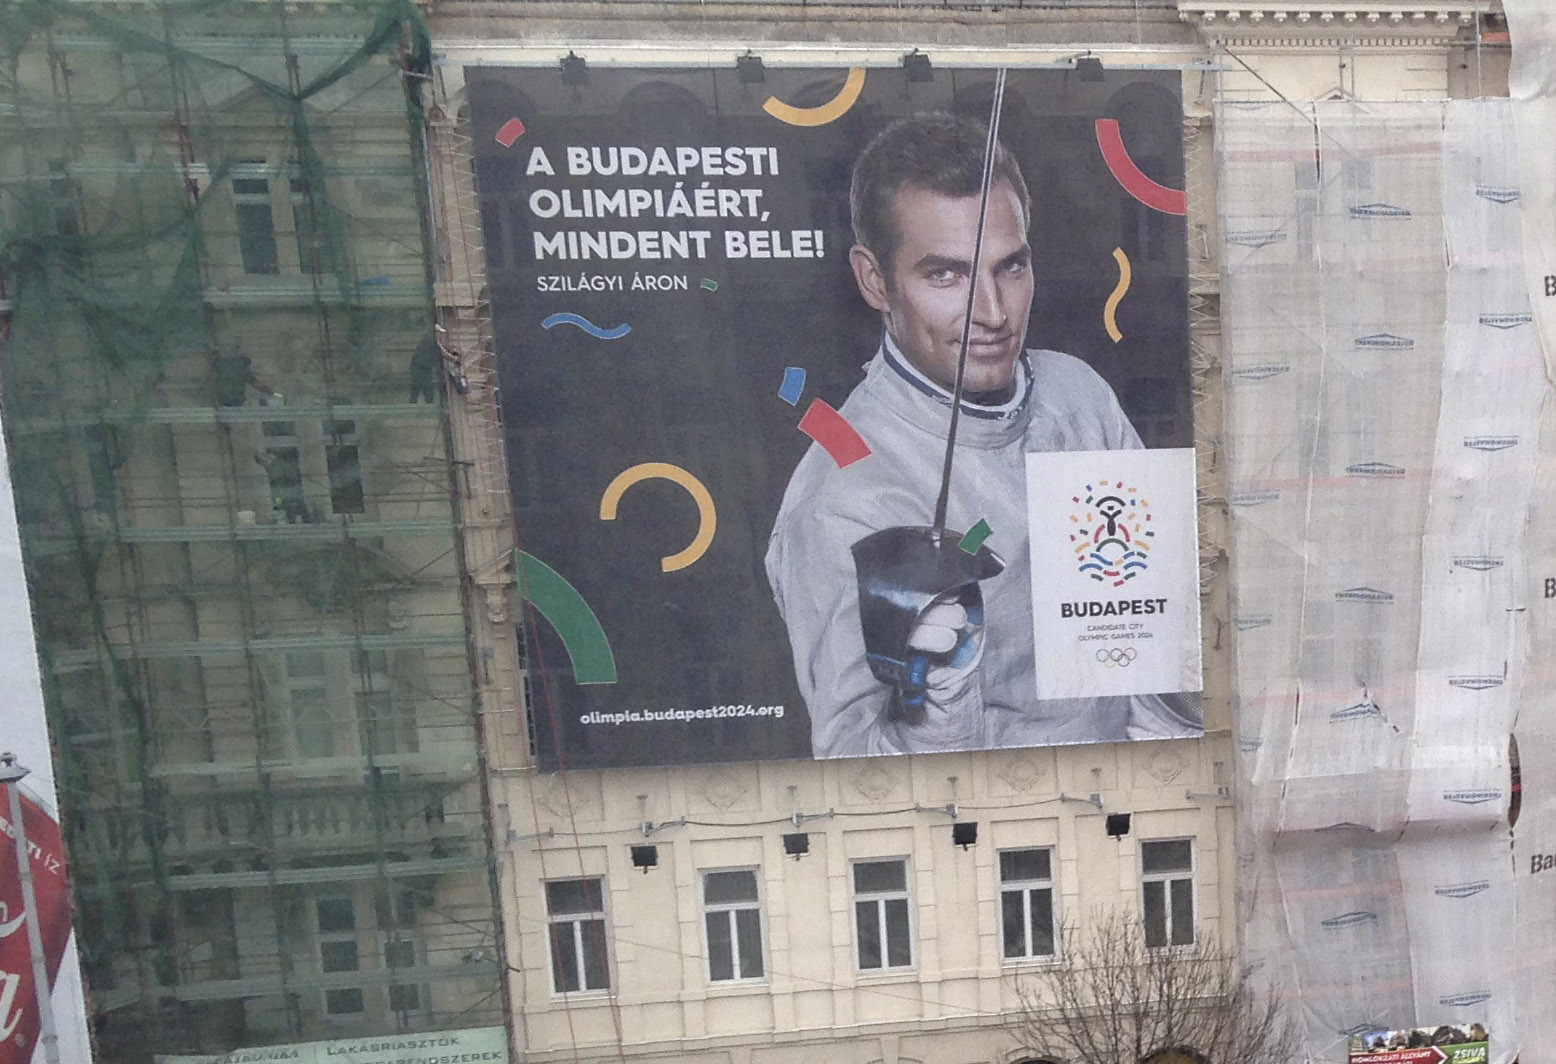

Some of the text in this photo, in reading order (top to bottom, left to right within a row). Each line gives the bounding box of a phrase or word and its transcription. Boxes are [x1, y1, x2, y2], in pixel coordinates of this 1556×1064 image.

[526, 146, 779, 176] A BUDAPESTI
[529, 181, 771, 222] OLIMPIÁÉRT,
[534, 230, 825, 260] MINDENT BELE!
[536, 273, 688, 292] SZILÁGYI ÁRON
[1061, 599, 1168, 619] BUDAPEST
[1078, 632, 1154, 642] OLYMPIC GAMES 2024
[1087, 624, 1126, 632] CANDIDATE
[580, 704, 785, 725] olimpia.budapest2024.org
